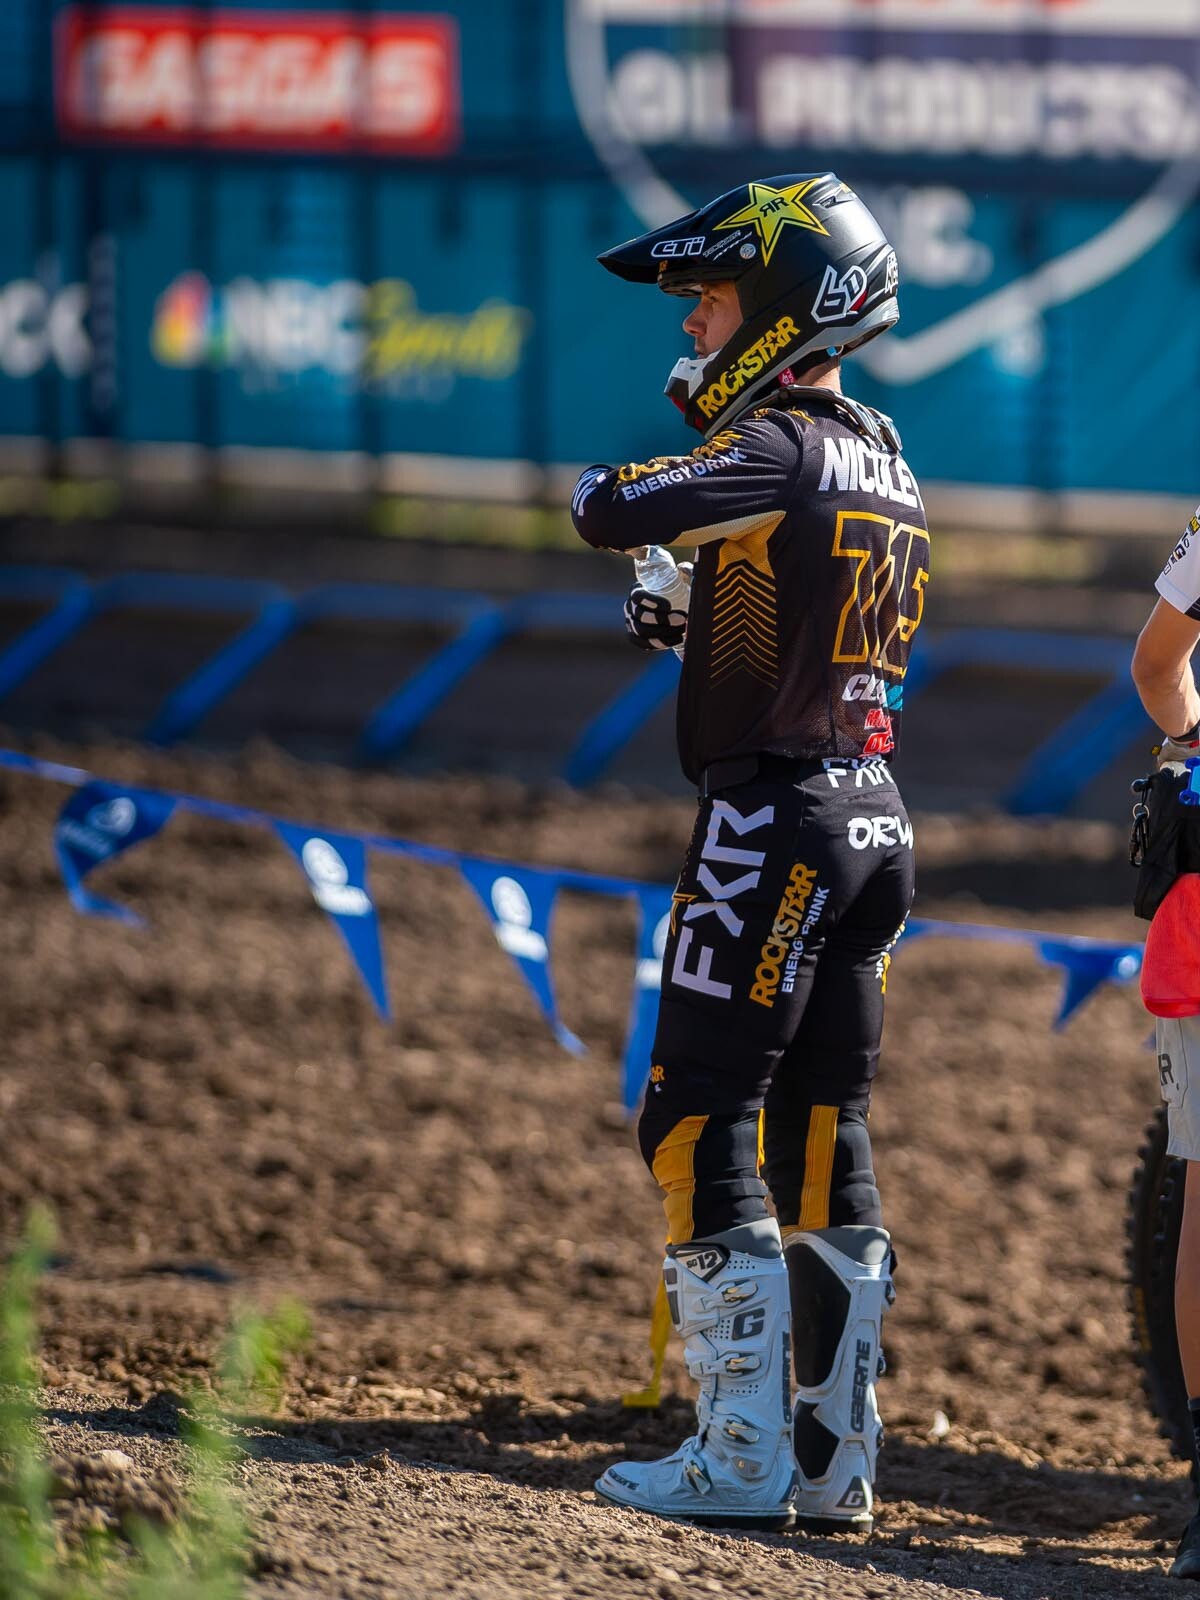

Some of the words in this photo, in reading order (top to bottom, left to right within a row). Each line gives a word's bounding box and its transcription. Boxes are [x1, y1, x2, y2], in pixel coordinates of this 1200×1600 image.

[696, 315, 800, 420] ROCKSTAR
[622, 463, 693, 501] ENERGY
[671, 799, 776, 1000] FXR
[749, 862, 818, 1008] ROCKSTAR
[781, 937, 805, 994] ENERG
[697, 1250, 718, 1271] 12
[850, 1337, 871, 1434] GAERNE
